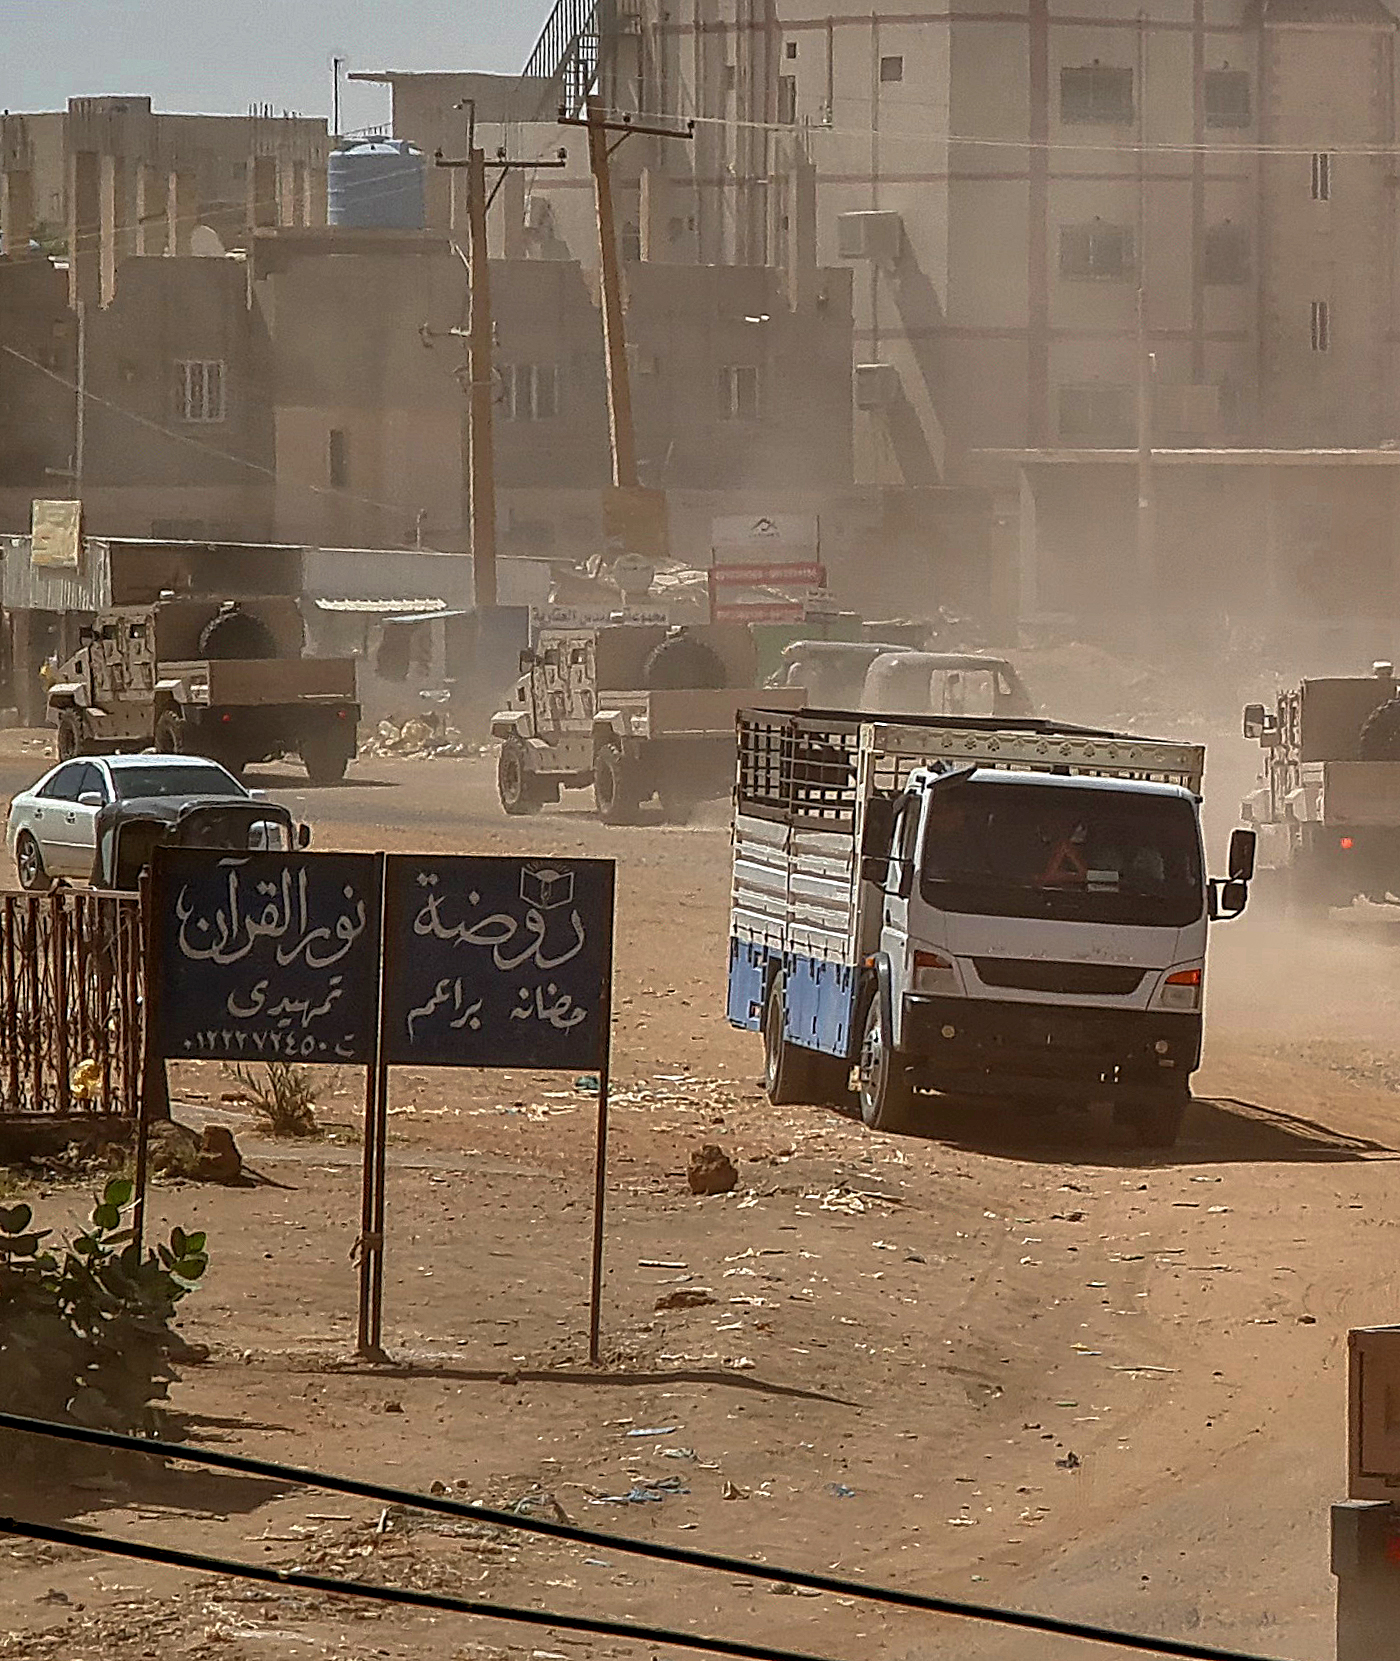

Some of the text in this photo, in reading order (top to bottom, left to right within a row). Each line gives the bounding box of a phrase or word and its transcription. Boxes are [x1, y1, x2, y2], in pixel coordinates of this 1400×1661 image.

[175, 856, 367, 969] نور القرآن
[413, 871, 586, 970] روضة
[407, 977, 483, 1045] براعم
